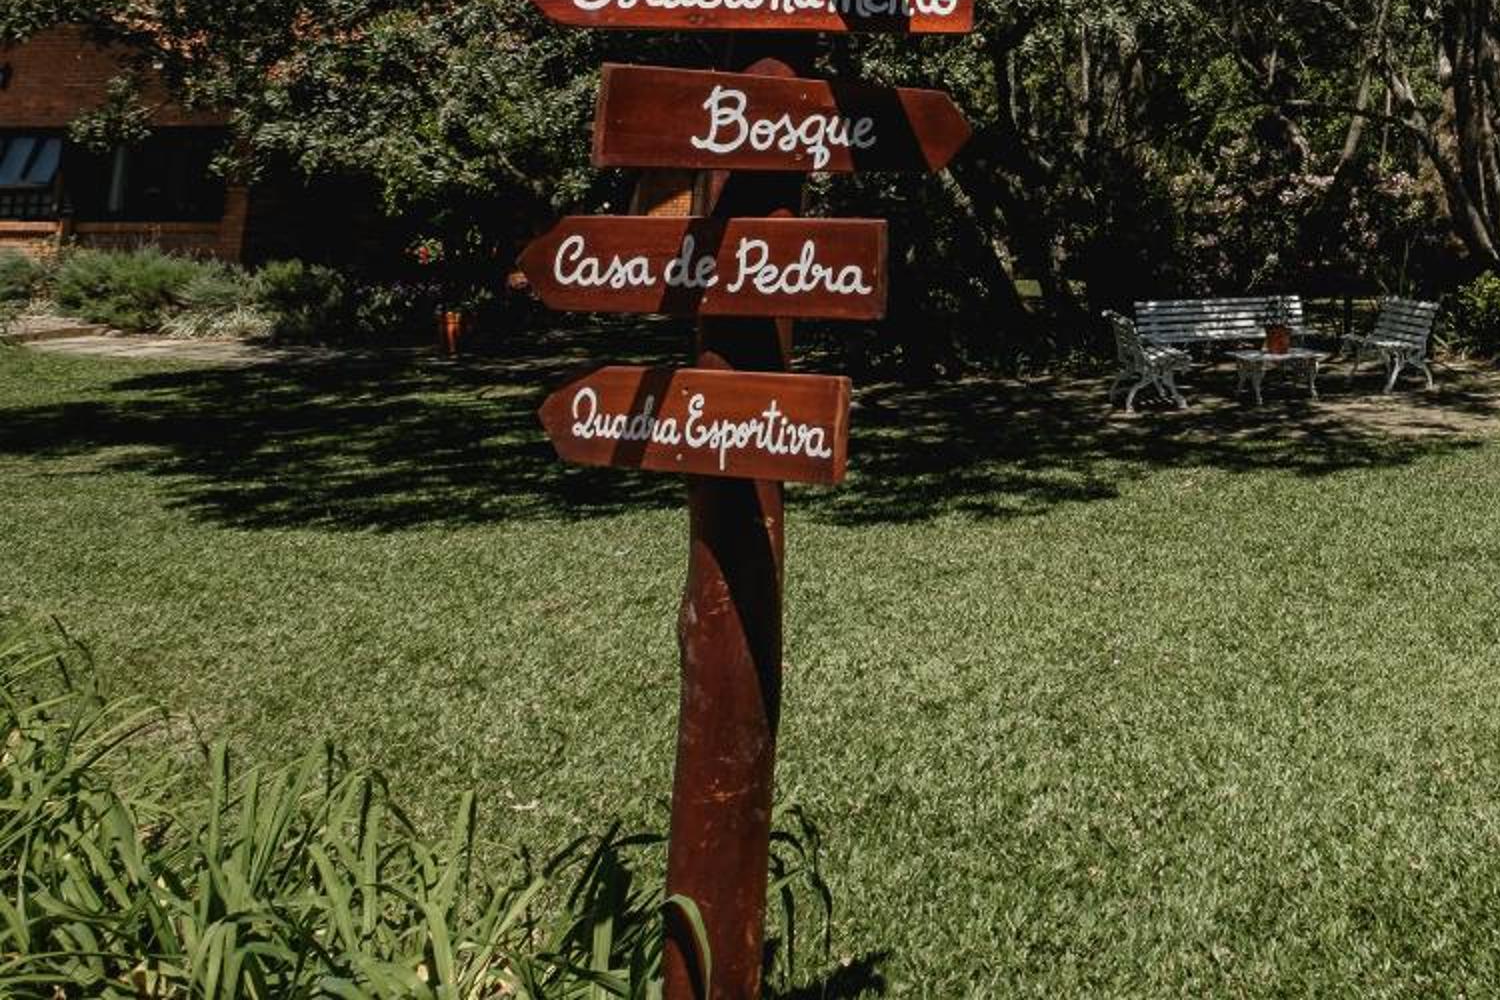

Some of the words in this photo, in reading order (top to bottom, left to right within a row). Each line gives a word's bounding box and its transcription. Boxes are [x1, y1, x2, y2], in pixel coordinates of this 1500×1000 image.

[690, 85, 877, 170] Bosque
[554, 235, 656, 288] Casa
[664, 233, 717, 288] de
[727, 237, 872, 296] Pedra
[571, 386, 680, 445] Quadra
[684, 394, 833, 471] Esportiva
